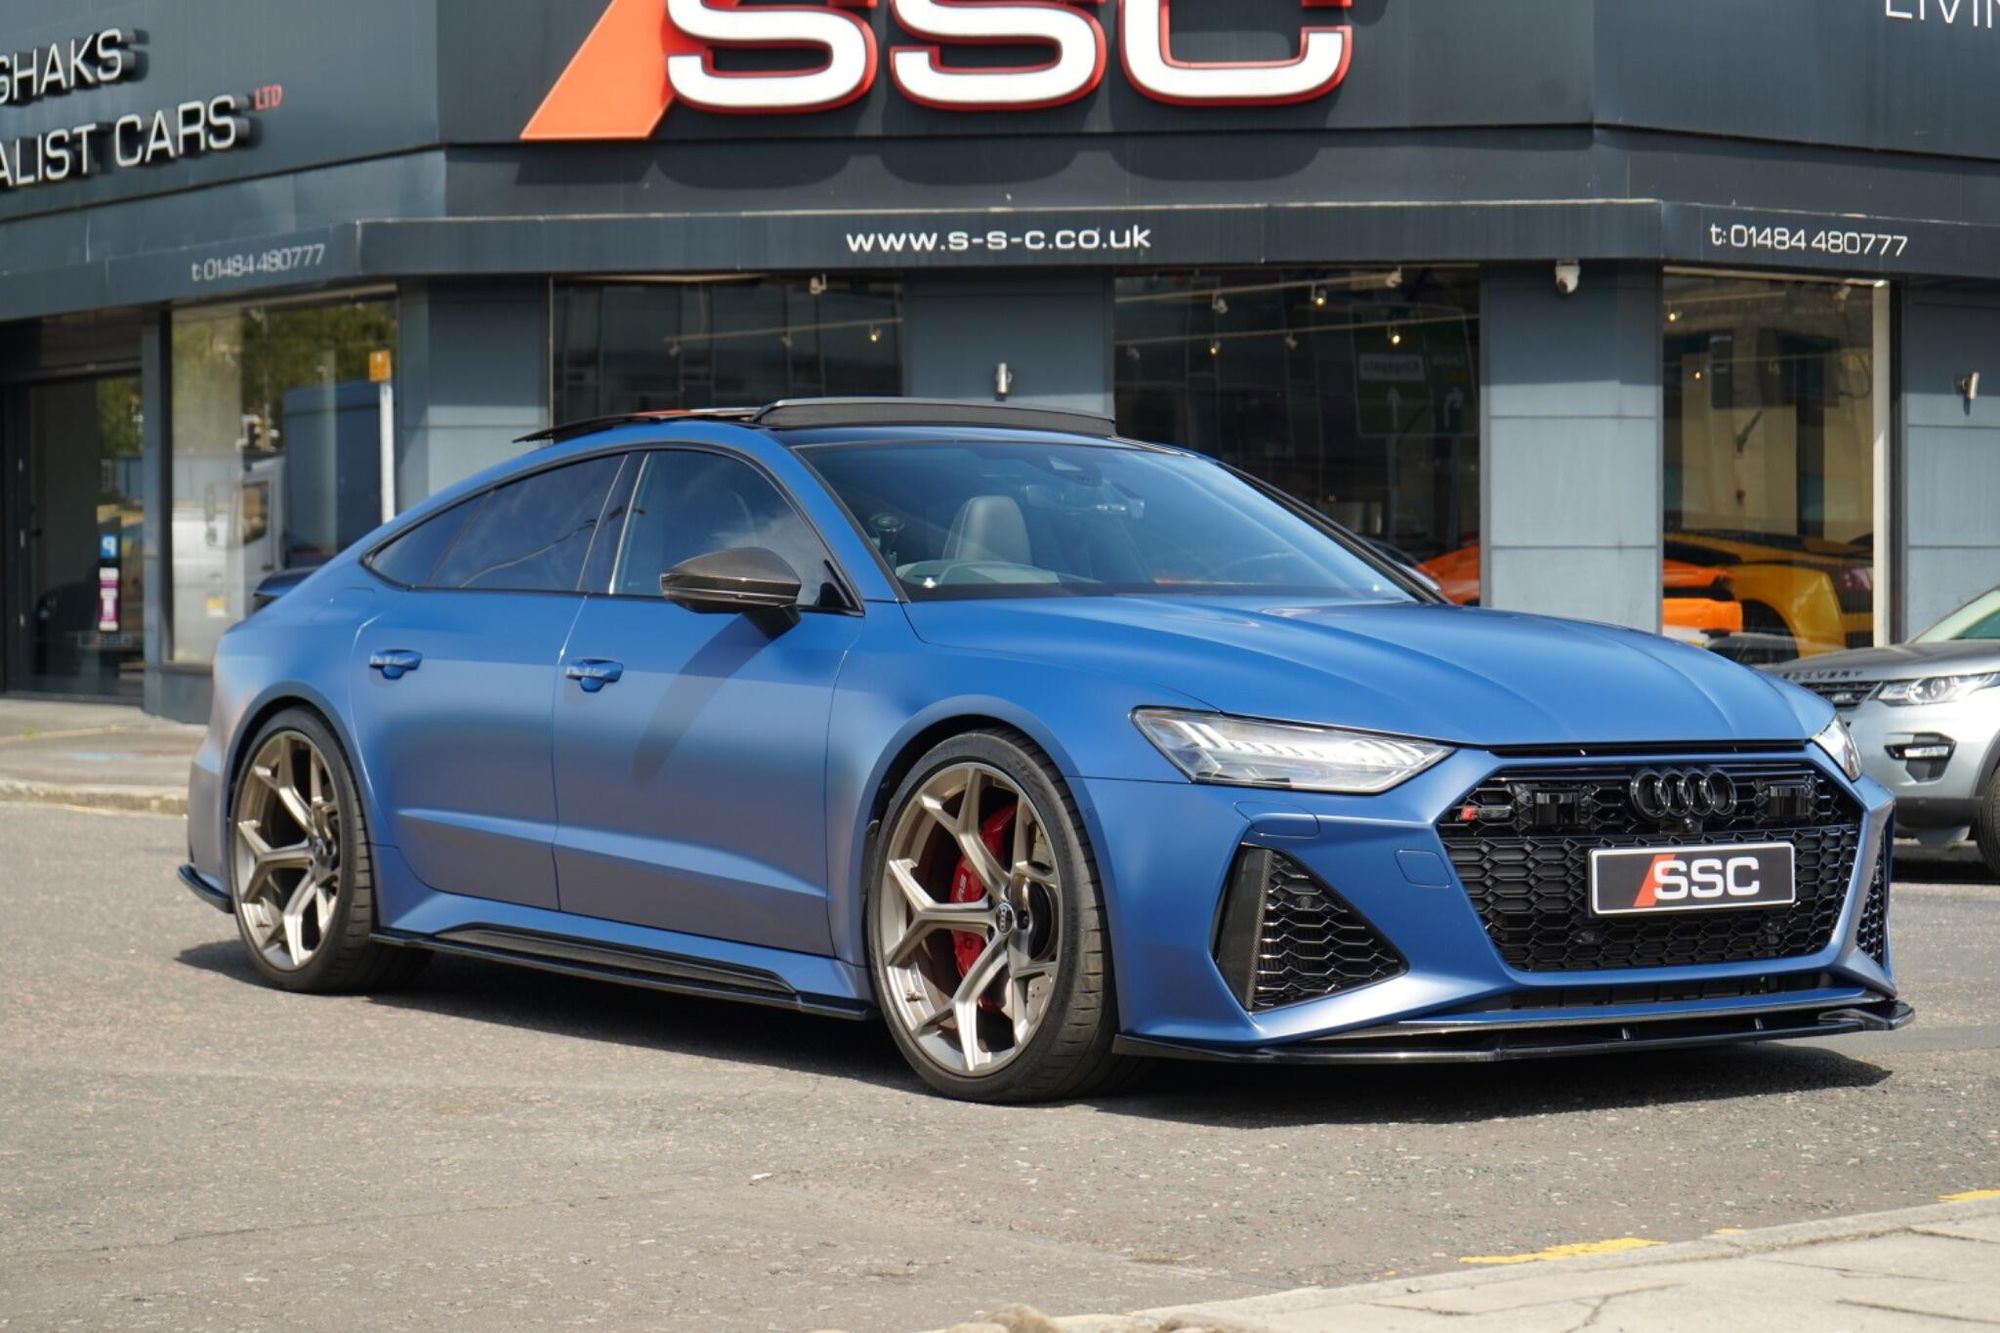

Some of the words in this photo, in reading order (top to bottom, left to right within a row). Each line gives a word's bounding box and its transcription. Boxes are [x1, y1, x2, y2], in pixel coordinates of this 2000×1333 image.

[115, 94, 236, 167] CARS
[254, 84, 283, 111] LTD
[845, 224, 1152, 253] www.s-s-c.co.uk
[1810, 229, 1909, 258] 480777
[1653, 856, 1760, 900] SSC
